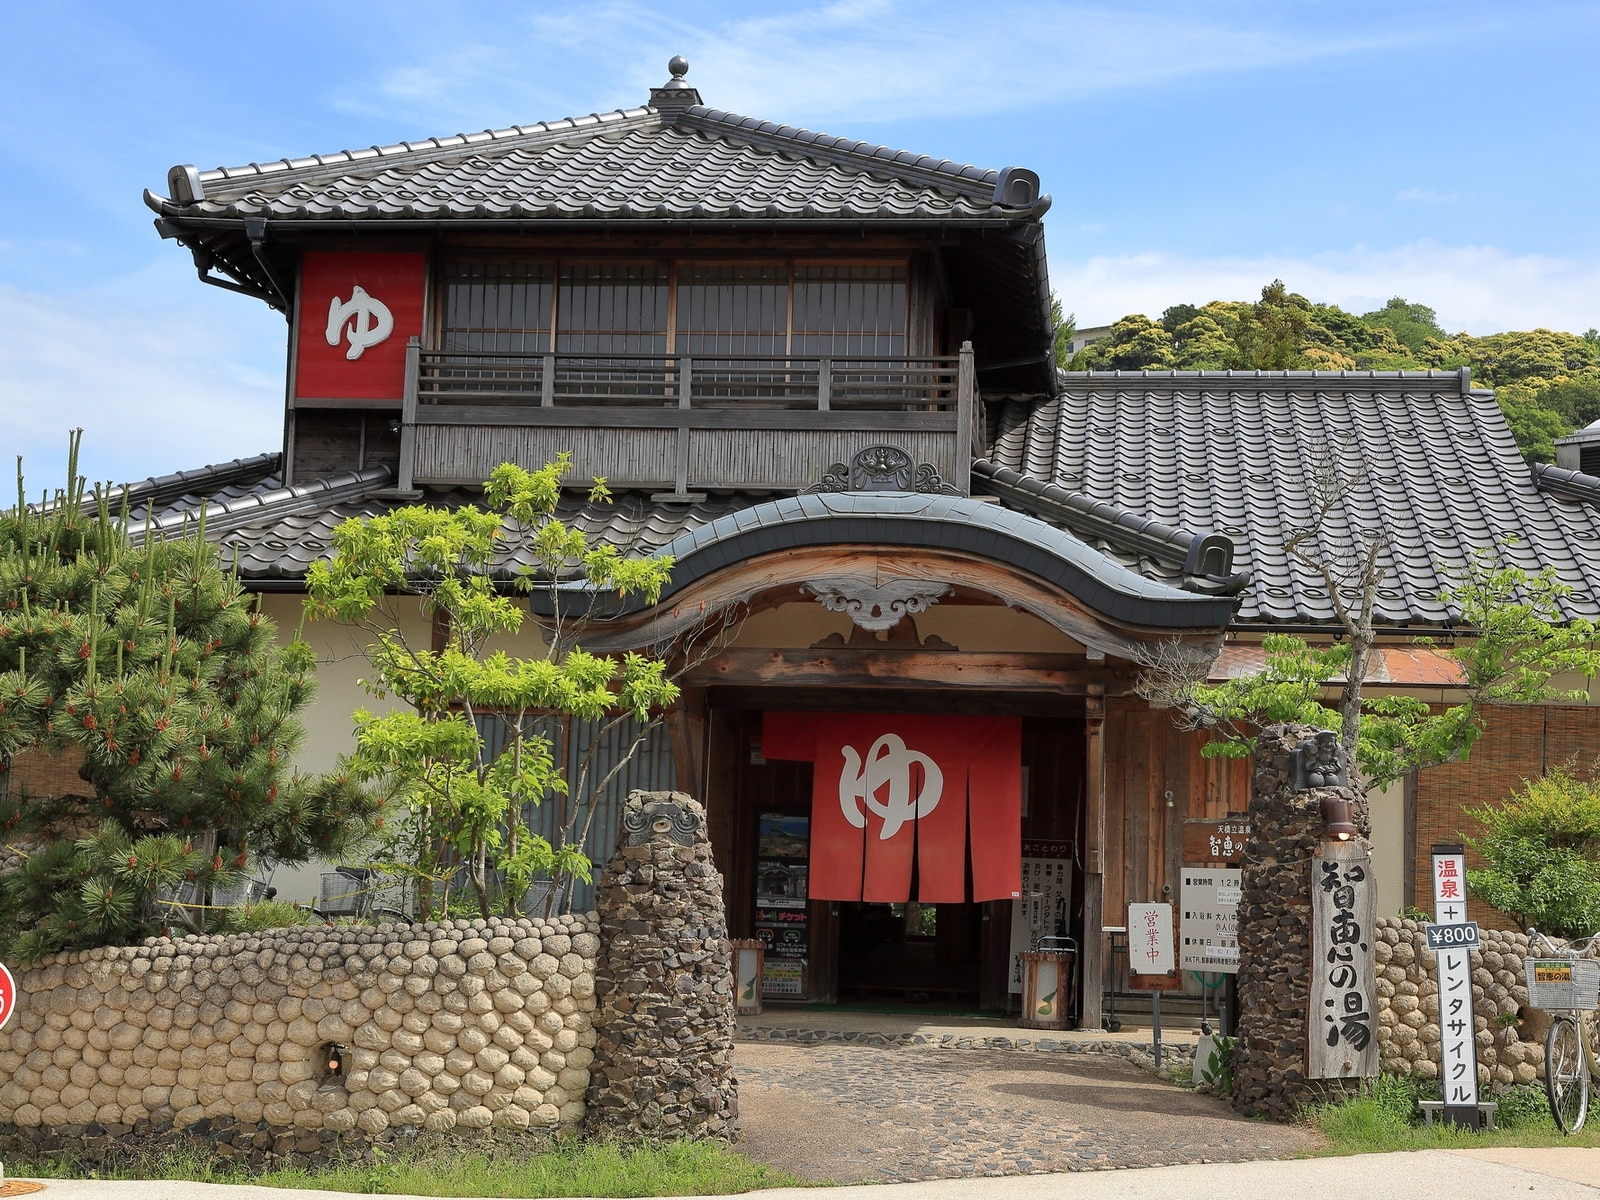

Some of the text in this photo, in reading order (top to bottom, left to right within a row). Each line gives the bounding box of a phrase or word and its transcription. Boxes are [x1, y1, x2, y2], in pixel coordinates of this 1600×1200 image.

[326, 285, 394, 360] ゆ
[839, 733, 944, 840] ゆ
[1217, 825, 1252, 834] 天橋立温泉
[1023, 844, 1067, 852] おことわり
[1209, 835, 1249, 856] 智恵の
[1192, 878, 1213, 887] 営業時間
[1438, 860, 1460, 898] 温泉
[1191, 912, 1213, 920] 入浴料
[1144, 910, 1160, 965] 営業中
[1191, 938, 1212, 947] 休業日
[1430, 926, 1476, 945] ¥800
[1320, 861, 1371, 1052] 智恵の湯
[1537, 972, 1571, 982] 智恵の湯
[1446, 954, 1472, 1103] レンタサイクル
